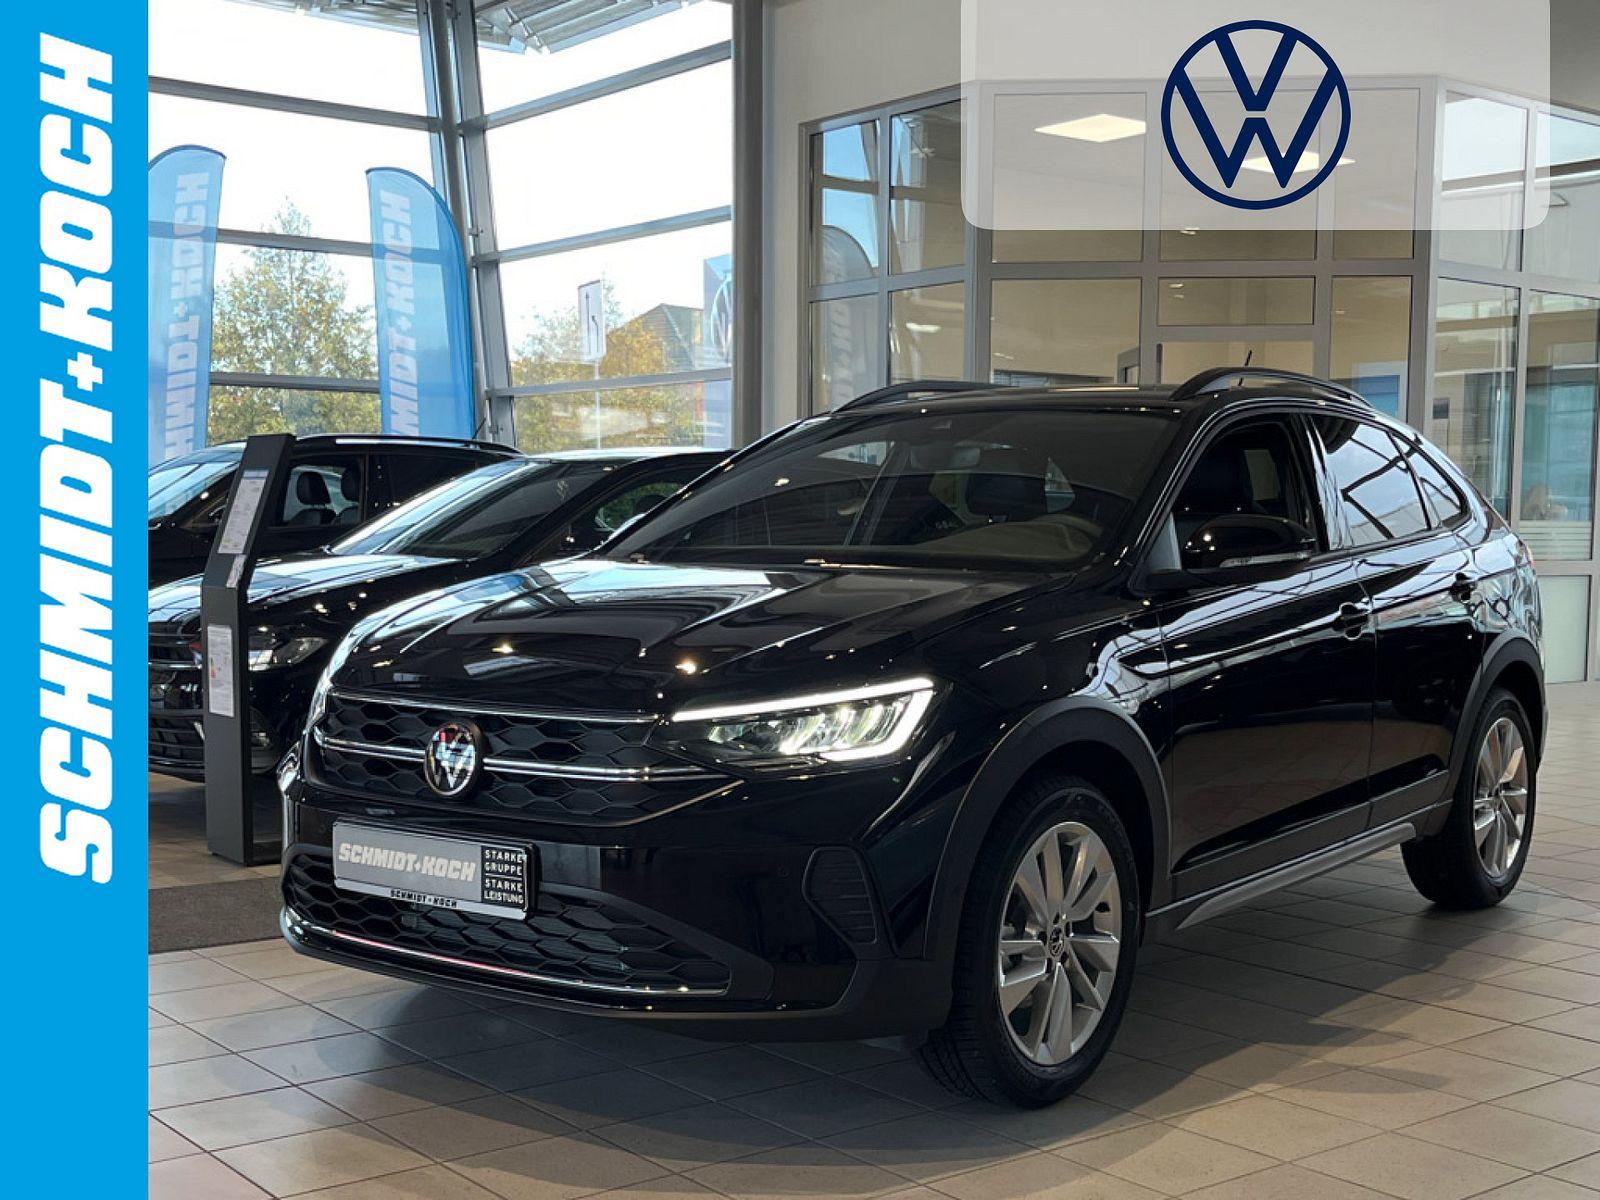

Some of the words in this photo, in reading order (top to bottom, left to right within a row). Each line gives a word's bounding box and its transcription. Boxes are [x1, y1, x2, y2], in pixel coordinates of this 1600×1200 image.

[338, 842, 476, 882] SCHMIDT+KOCH
[485, 849, 523, 863] STARKE
[485, 861, 523, 876] GRUPPE
[485, 877, 523, 893] STARKE
